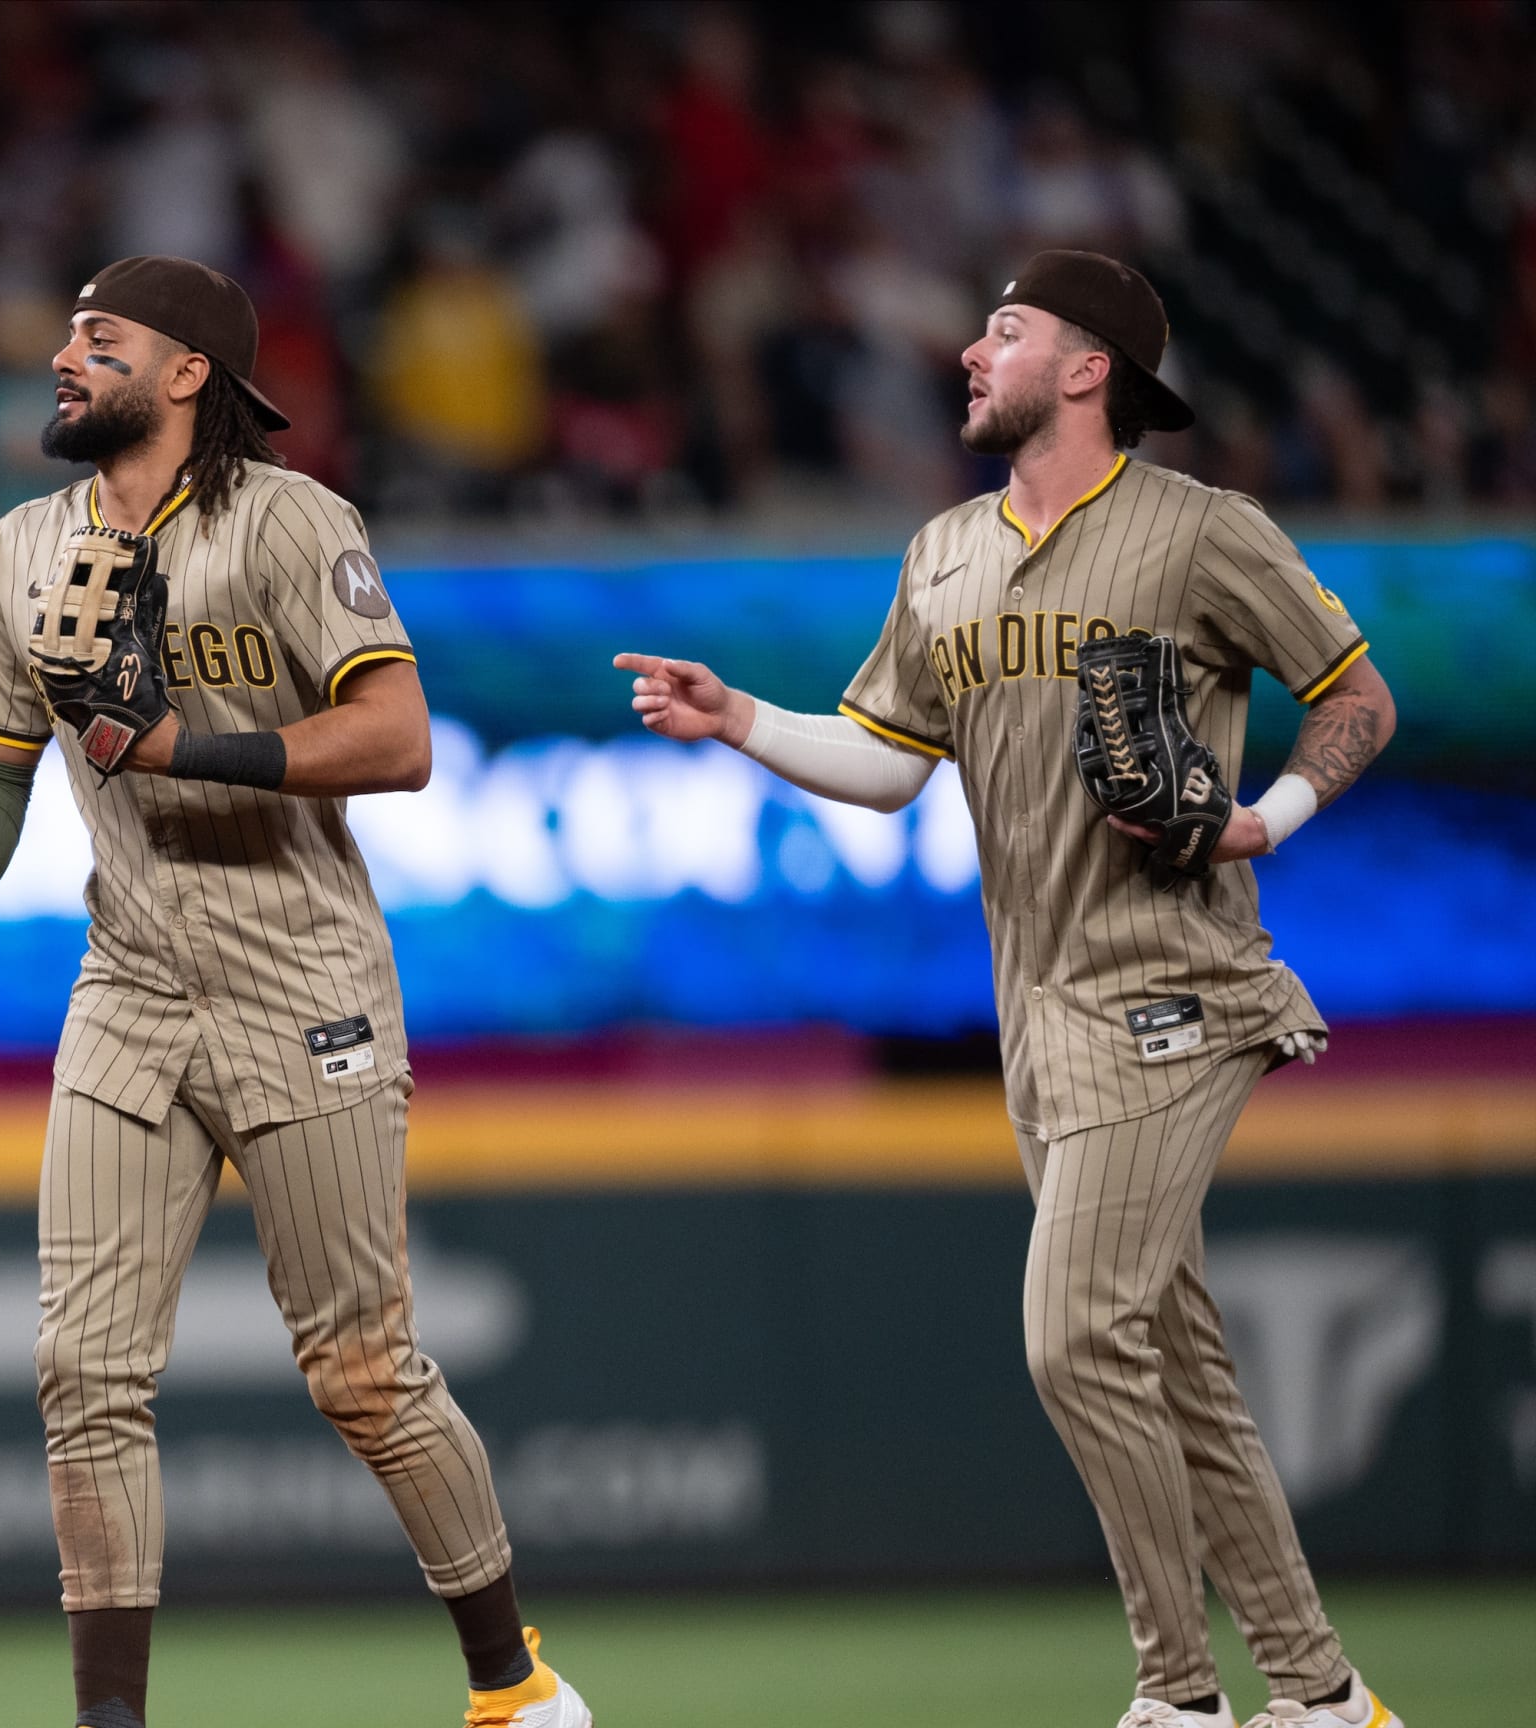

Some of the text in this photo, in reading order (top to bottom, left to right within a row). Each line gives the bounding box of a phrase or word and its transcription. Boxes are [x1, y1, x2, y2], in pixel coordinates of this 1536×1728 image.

[164, 622, 277, 689] EGO
[930, 611, 1154, 706] AN DIE
